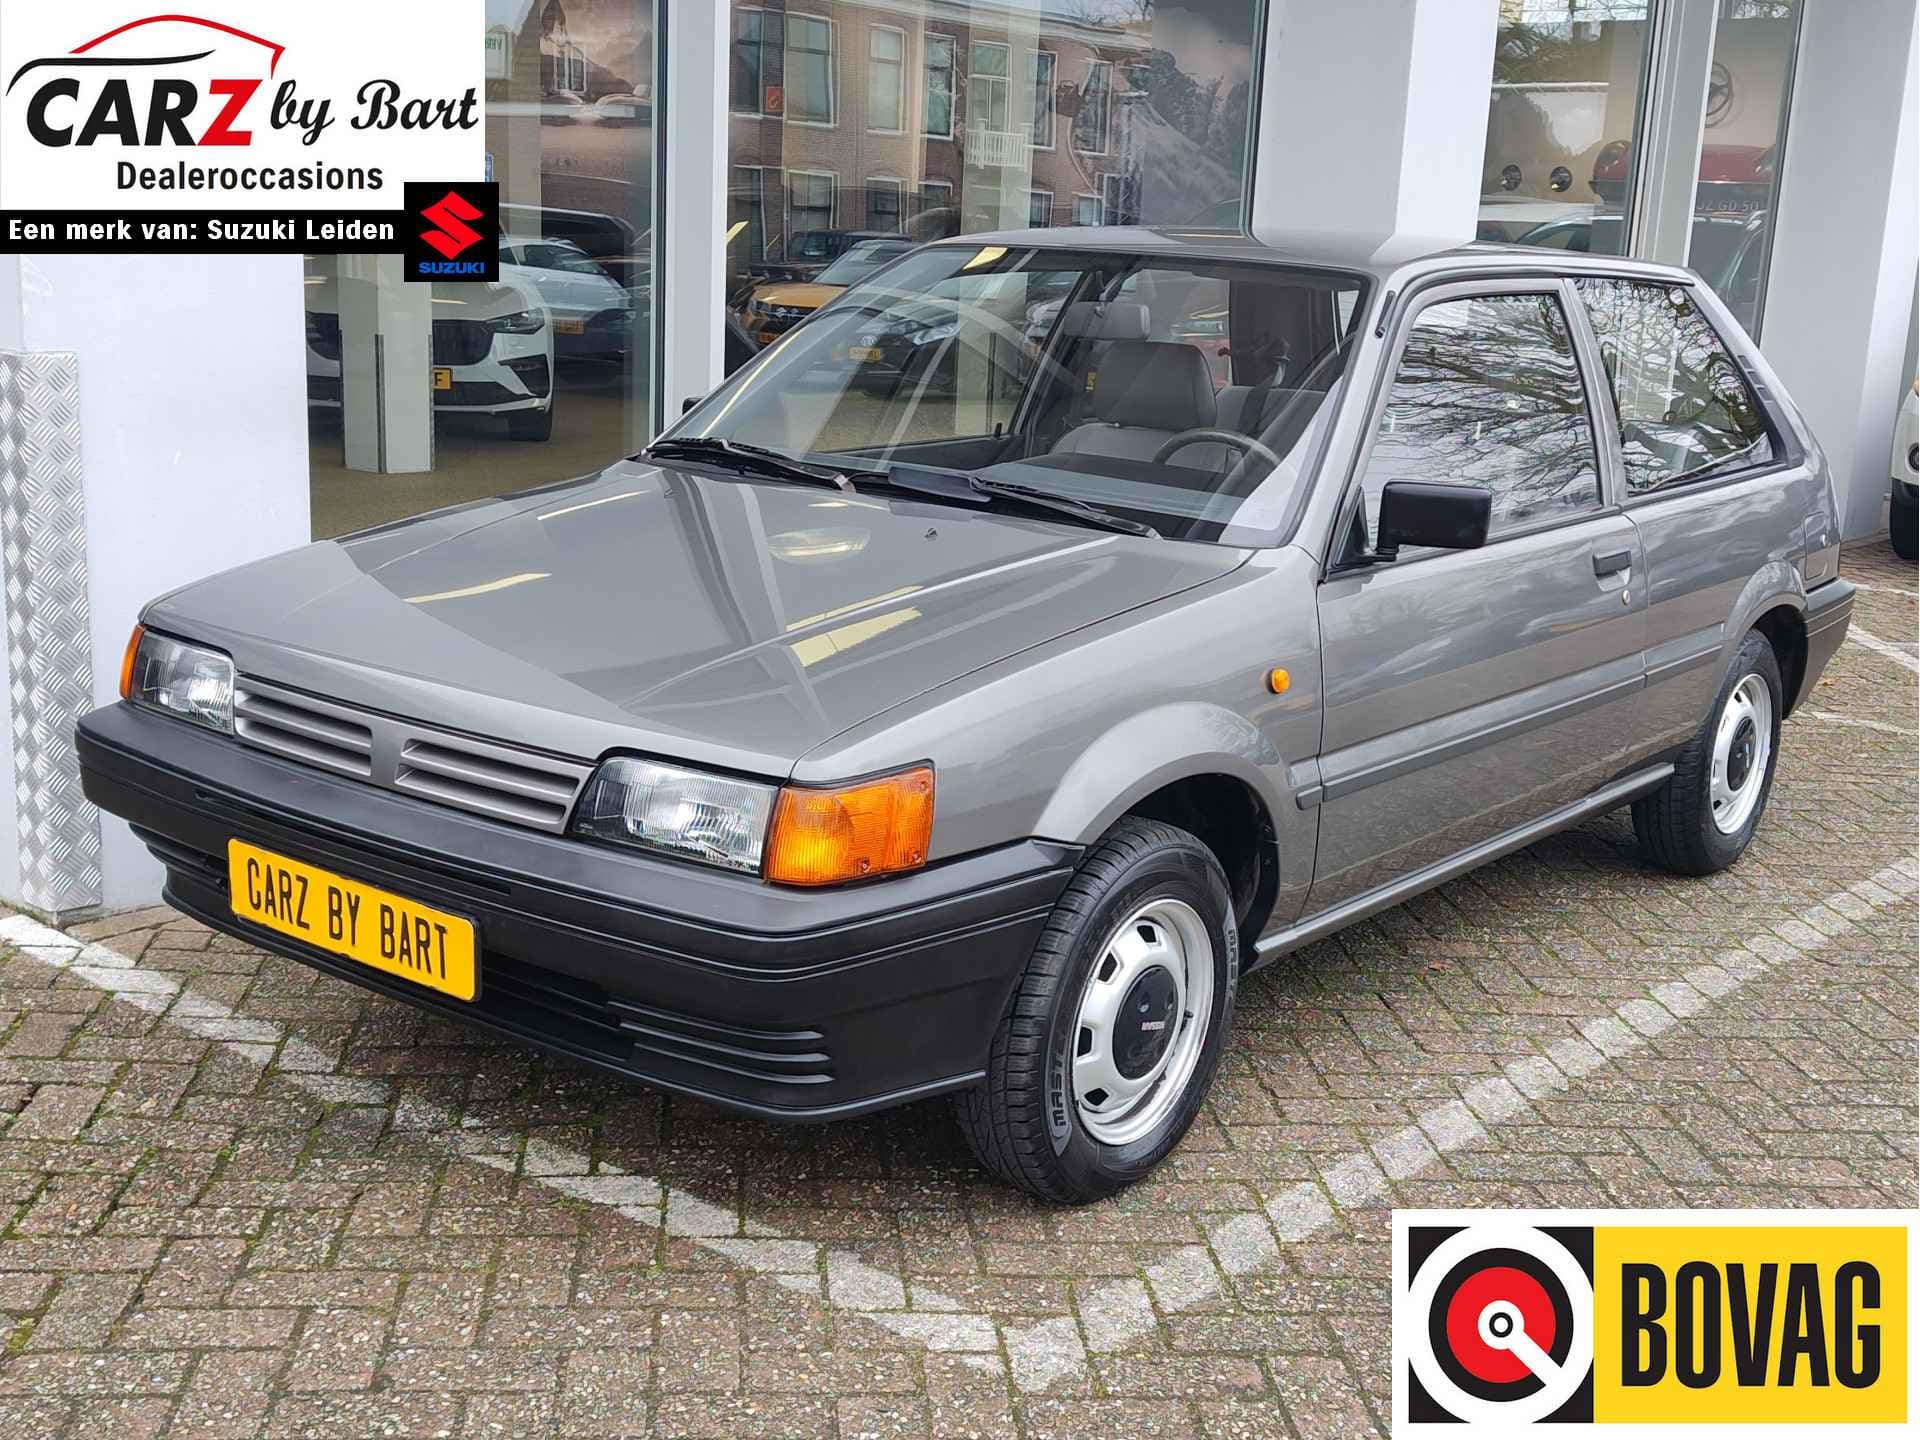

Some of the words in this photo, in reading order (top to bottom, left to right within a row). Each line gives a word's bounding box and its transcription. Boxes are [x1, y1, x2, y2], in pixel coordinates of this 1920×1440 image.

[247, 857, 310, 930] CARZ
[328, 885, 361, 947] BY
[380, 903, 448, 980] BART
